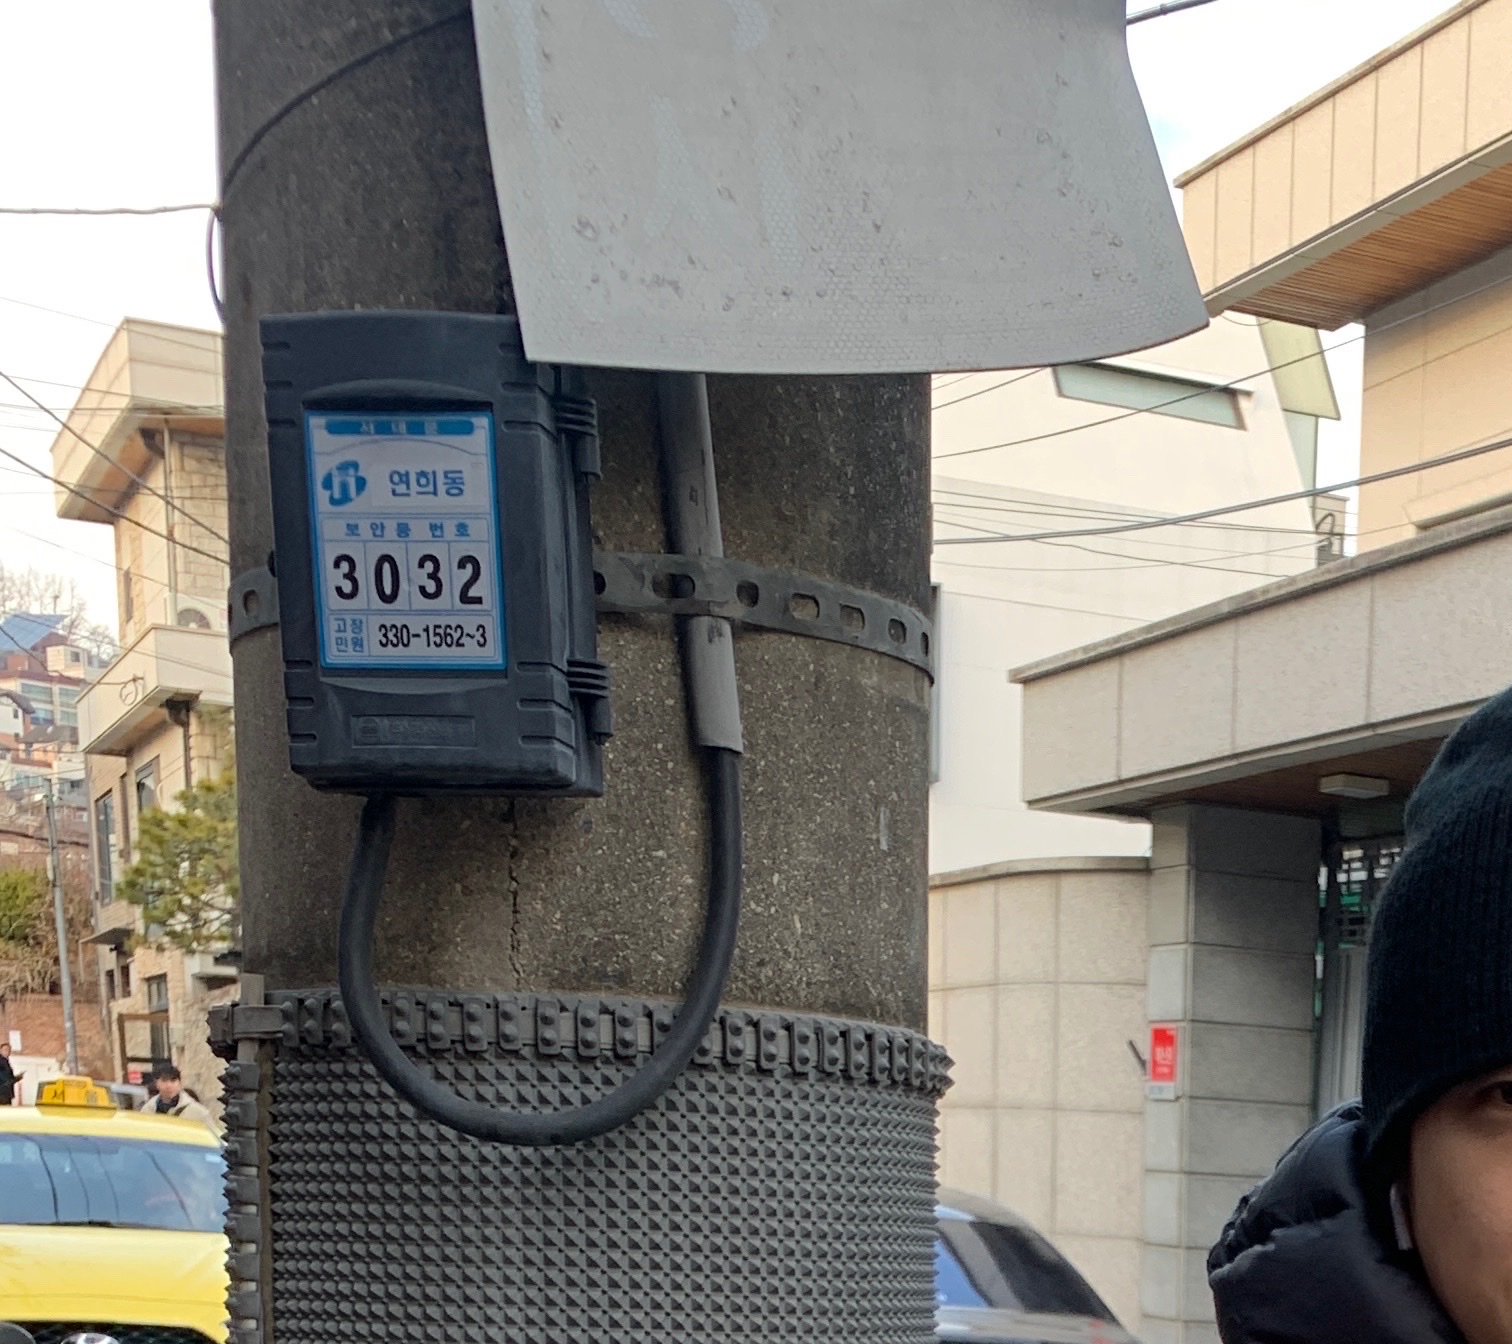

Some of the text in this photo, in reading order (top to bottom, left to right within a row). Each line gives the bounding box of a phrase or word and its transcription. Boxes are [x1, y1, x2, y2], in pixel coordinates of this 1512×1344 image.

[389, 469, 465, 498] 연희동
[345, 521, 470, 538] 보안등 번호
[333, 553, 484, 605] 3032
[378, 623, 488, 648] 330-1562~3
